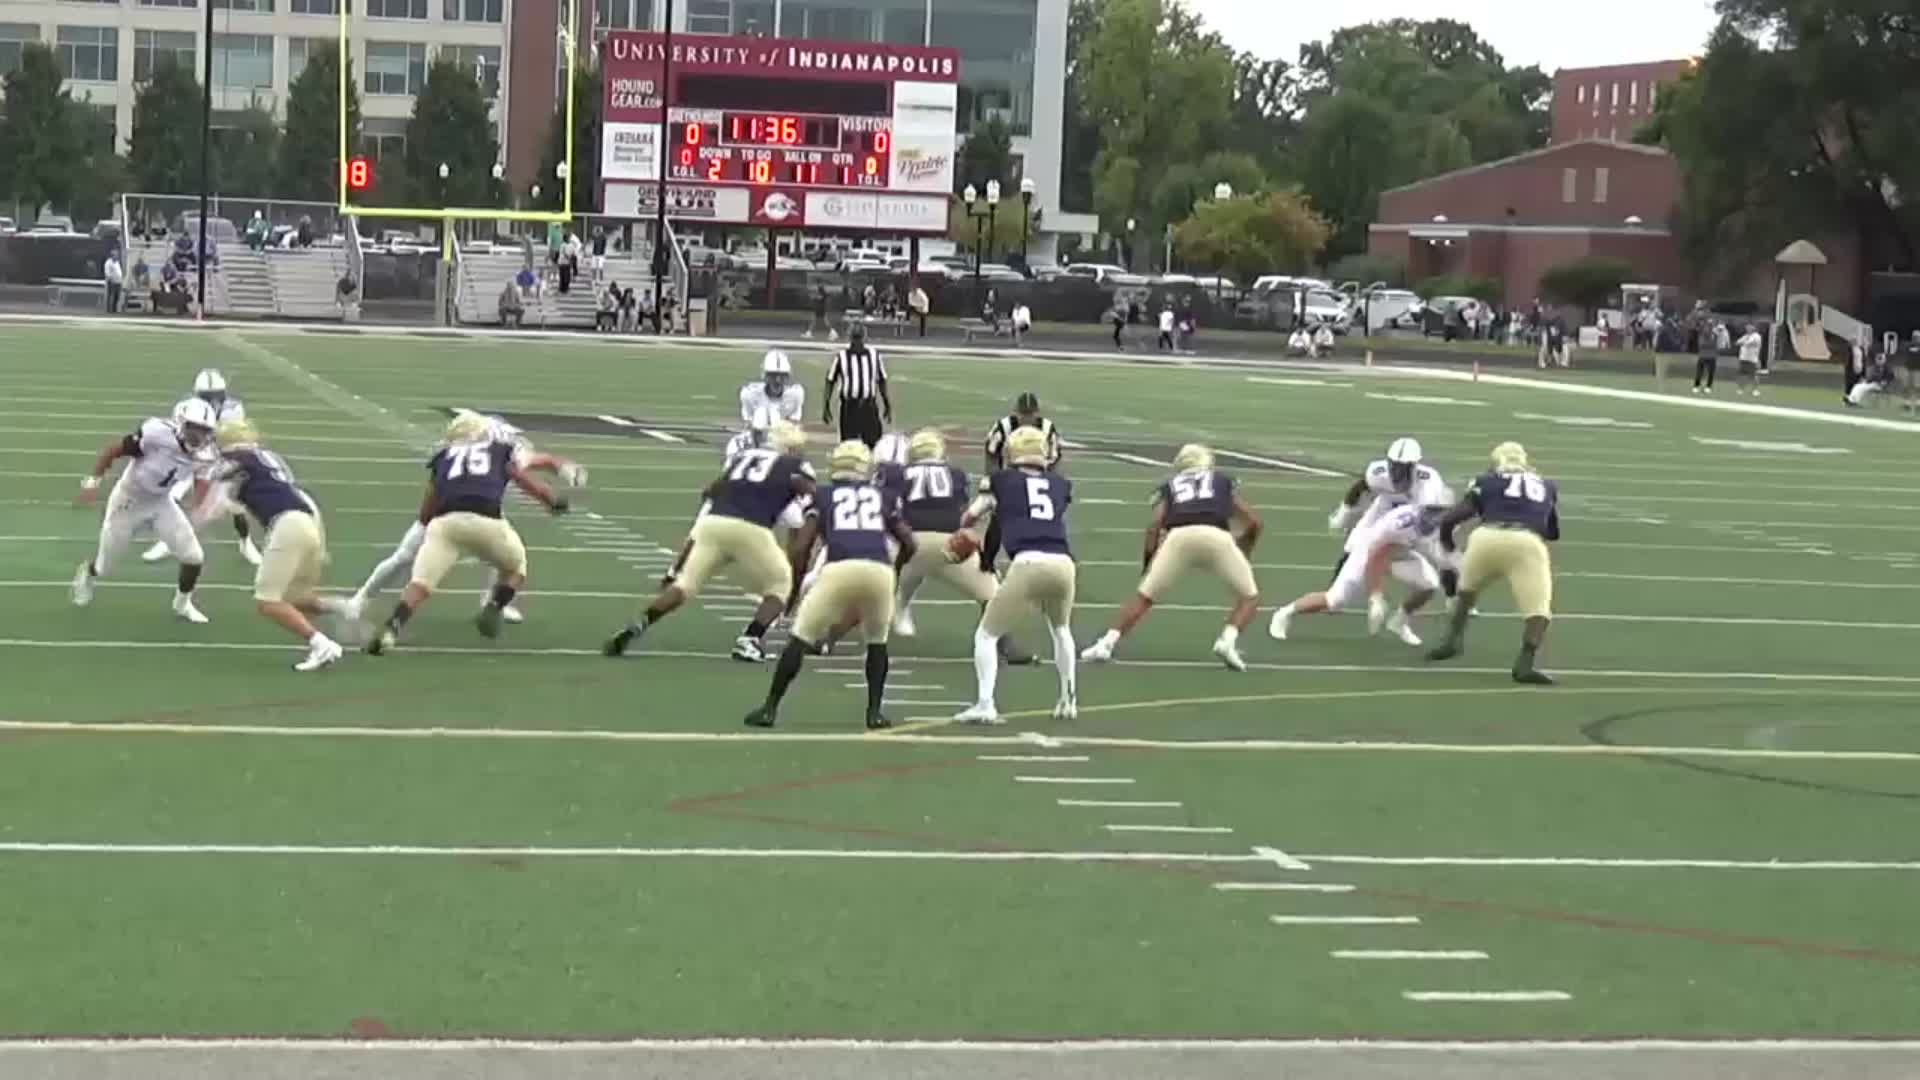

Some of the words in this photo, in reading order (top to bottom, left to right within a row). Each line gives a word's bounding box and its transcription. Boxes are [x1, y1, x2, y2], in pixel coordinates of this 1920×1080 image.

[613, 39, 749, 65] UNIVERSITY
[788, 47, 953, 75] INDIANAPOLIS
[611, 79, 655, 94] HOUND
[686, 122, 699, 145] 0
[732, 116, 797, 143] 11:36
[699, 146, 732, 160] DOWN
[874, 131, 887, 153] 0
[681, 148, 693, 166] 0
[741, 149, 755, 161] TO
[756, 150, 772, 161] GO
[865, 156, 877, 175] 0
[708, 158, 721, 181] 2
[749, 161, 769, 183] 10
[796, 164, 816, 183] 11
[638, 186, 716, 199] GRYHOUND
[445, 441, 491, 479] 75
[729, 449, 780, 482] 73
[904, 465, 954, 501] 70
[1502, 472, 1545, 503] 76
[832, 486, 884, 531] 22
[1025, 477, 1055, 520] 5
